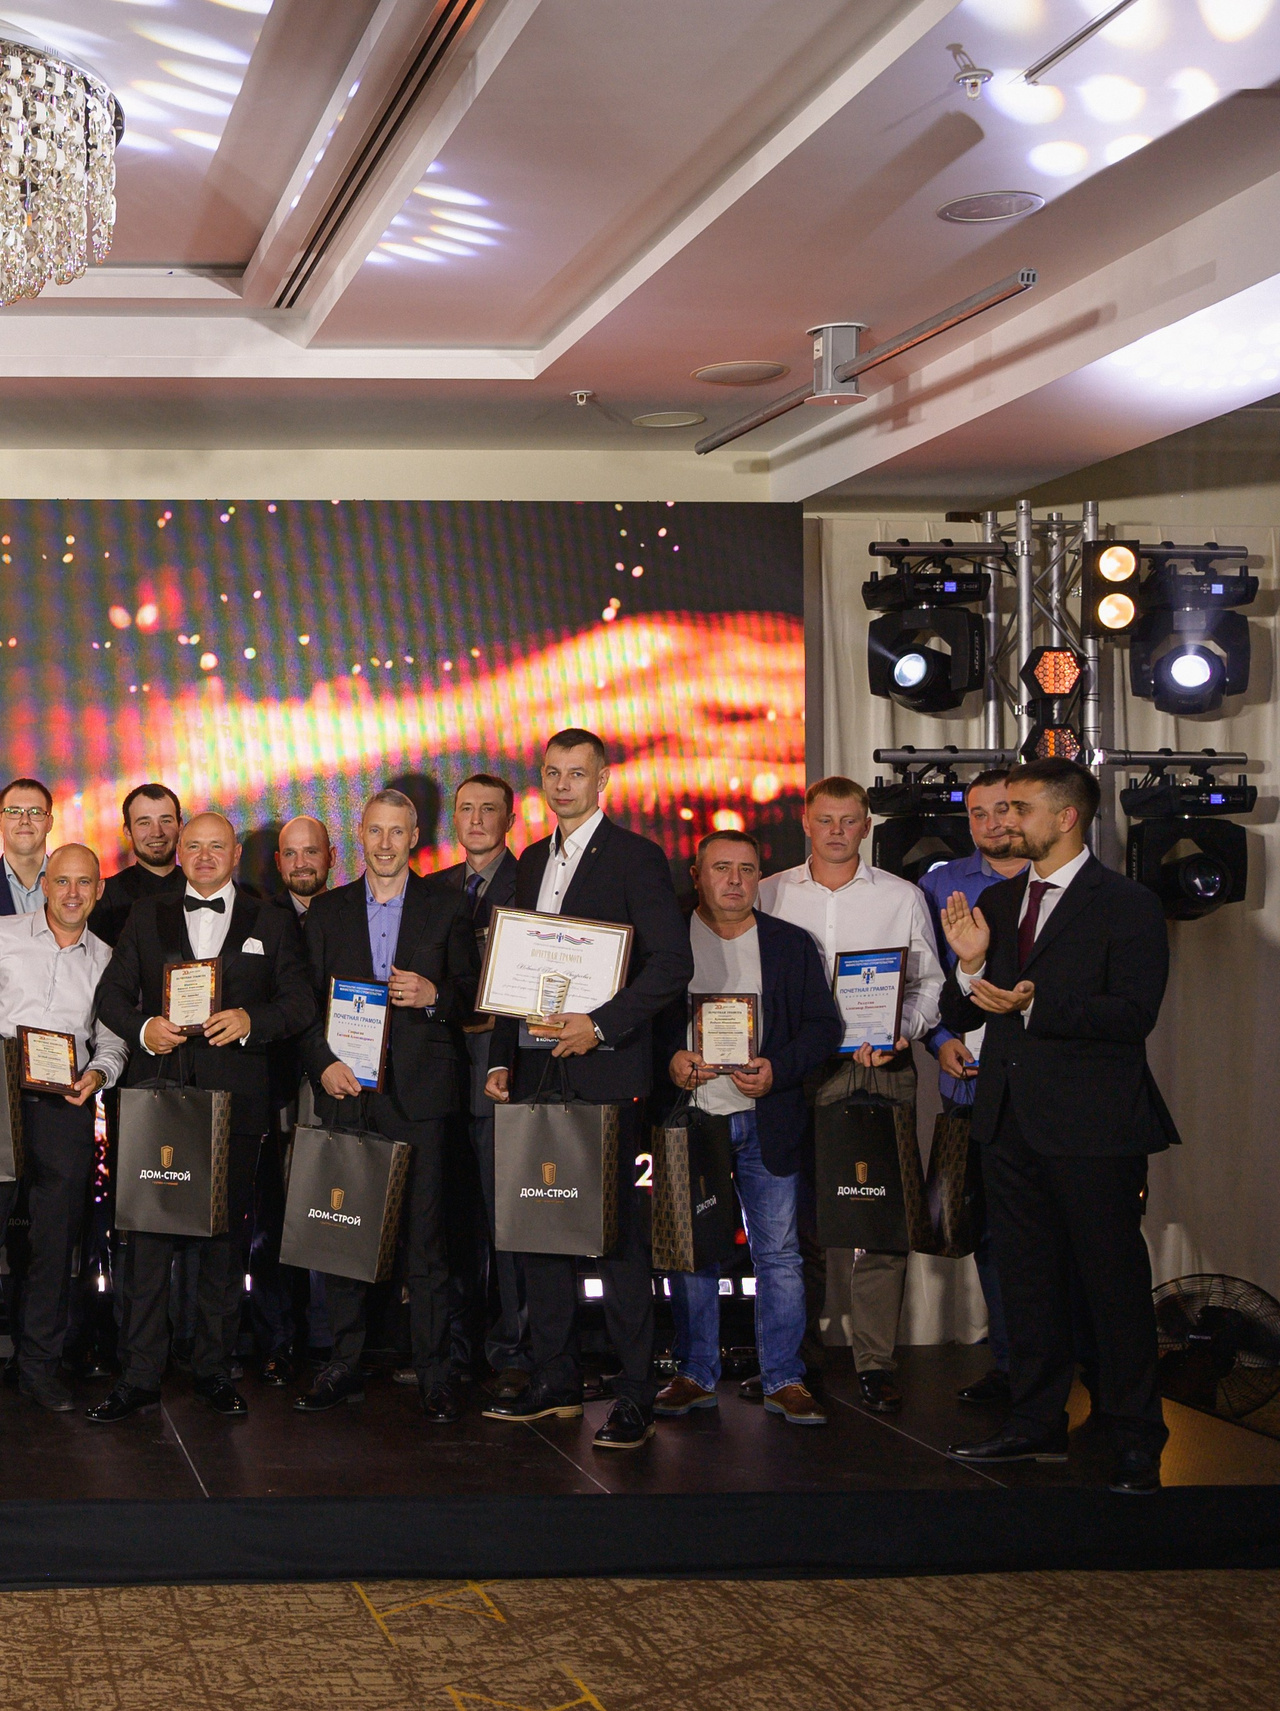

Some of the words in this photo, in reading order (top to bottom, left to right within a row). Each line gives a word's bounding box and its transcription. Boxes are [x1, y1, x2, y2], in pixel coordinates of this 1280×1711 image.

[333, 1012, 360, 1021] ПОЧЕТНАЯ
[360, 1016, 382, 1025] ГРАМОТА
[139, 1169, 191, 1182] ДОМ-СТРОЙ
[519, 1187, 579, 1199] ДОМ-СТРОЙ
[837, 1186, 886, 1197] ДОМ-СТРОЙ
[696, 1194, 717, 1215] ДОМ-СТРОЙ
[307, 1208, 362, 1226] ДОМ-СТРОЙ
